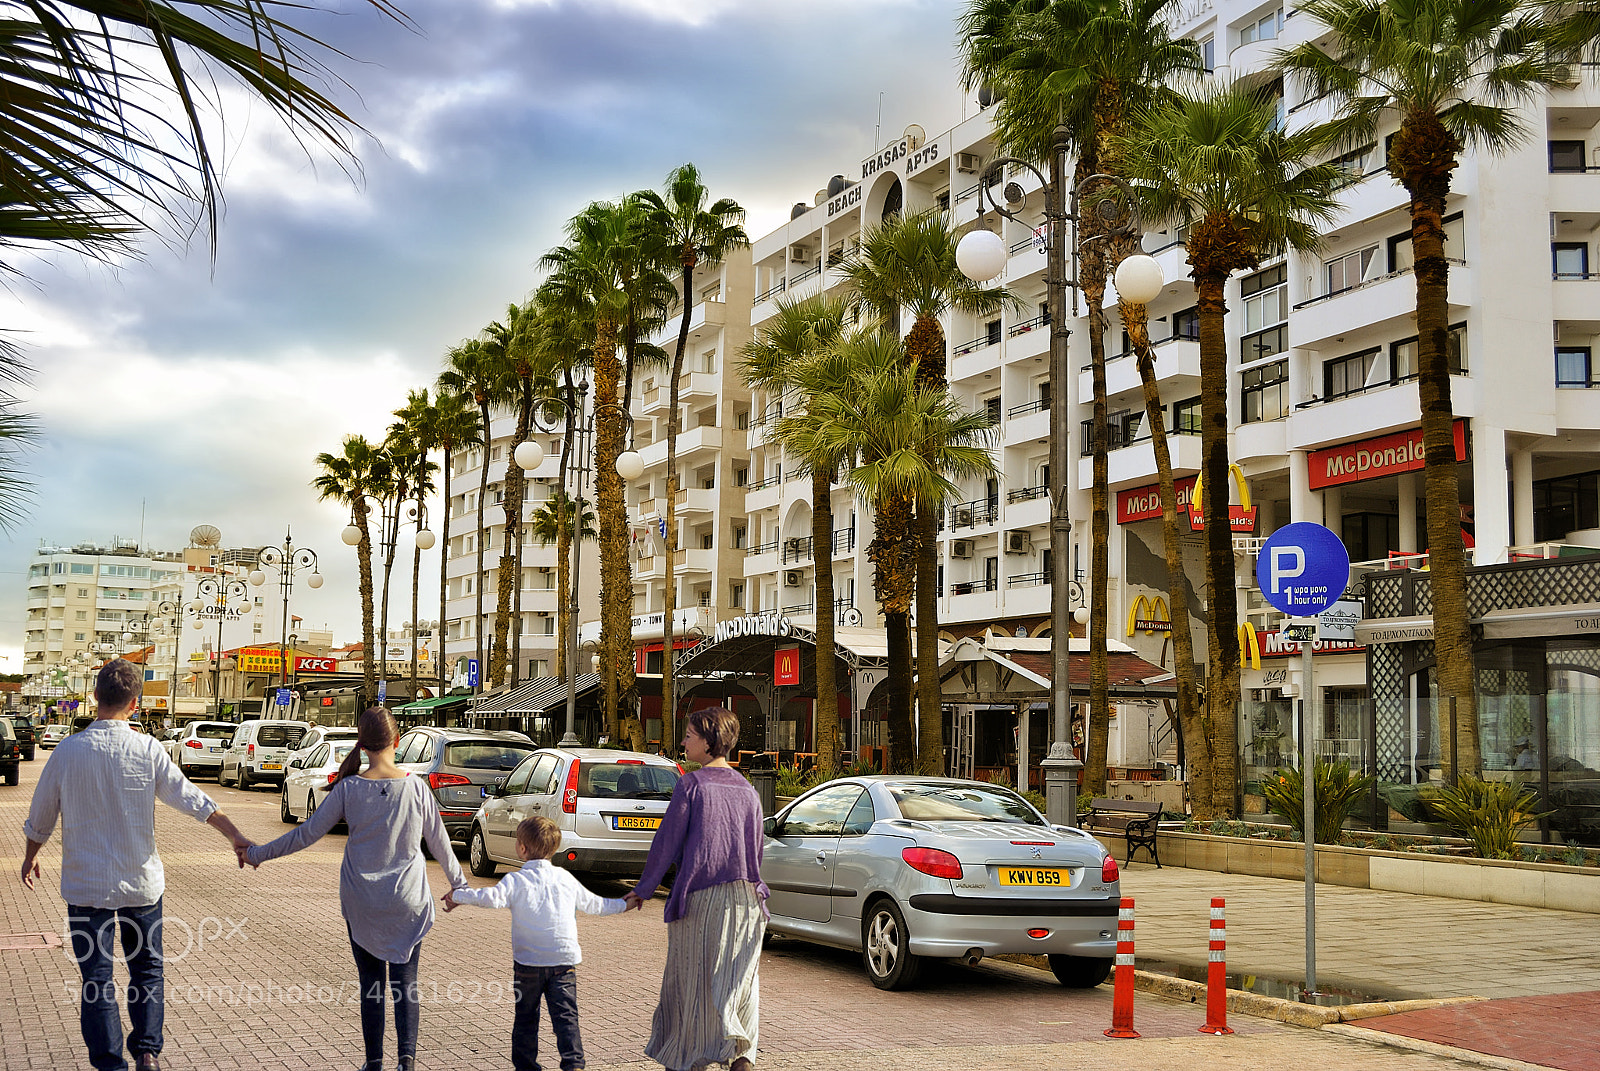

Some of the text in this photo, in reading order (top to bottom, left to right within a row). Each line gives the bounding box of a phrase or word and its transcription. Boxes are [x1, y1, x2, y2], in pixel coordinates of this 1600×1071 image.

[827, 141, 938, 217] BEACH KRASAS APTS
[1326, 438, 1425, 478] McDonald
[1270, 545, 1306, 594] P
[1283, 586, 1292, 606] 1
[1294, 594, 1328, 607] hour only
[715, 613, 791, 644] McDonald's
[1136, 621, 1173, 631] McDonal
[246, 664, 280, 672] DRINKS
[298, 658, 331, 670] KFC
[470, 661, 477, 681] P
[622, 818, 656, 828] KRS677
[1008, 870, 1061, 885] KWV 859
